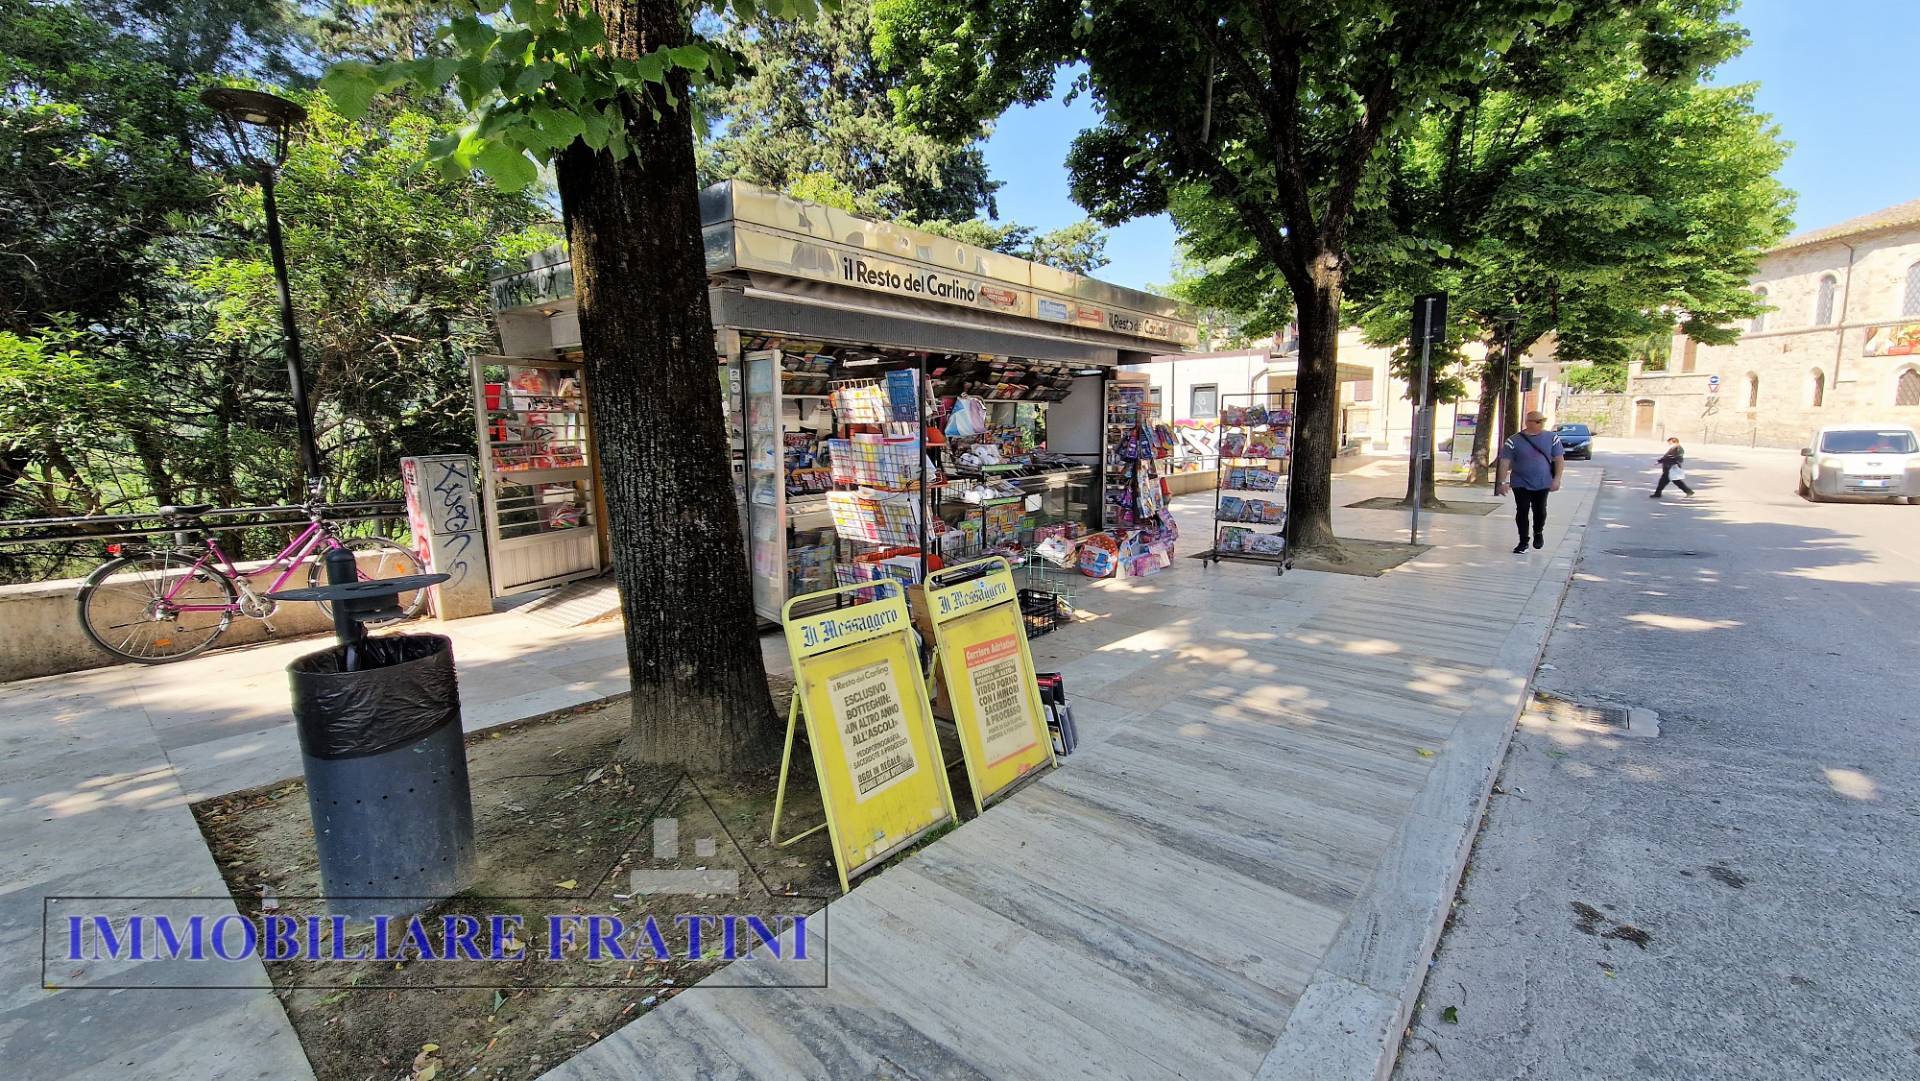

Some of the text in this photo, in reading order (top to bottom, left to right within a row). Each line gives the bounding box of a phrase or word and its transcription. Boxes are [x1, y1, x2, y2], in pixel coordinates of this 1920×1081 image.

[844, 257, 852, 280] il
[856, 260, 900, 289] Resto
[904, 273, 924, 292] del
[927, 274, 975, 302] Carlino
[1114, 314, 1132, 331] Resto
[938, 582, 1006, 614] Il Messaggero
[801, 609, 898, 648] Il Messaggero
[836, 678, 855, 690] Resto
[865, 666, 888, 679] Carlino
[976, 674, 1018, 696] VIDEO PORNO
[844, 682, 886, 706] ESCLUSIVO
[979, 692, 993, 706] CON
[997, 684, 1019, 698] MINORI
[985, 695, 1018, 716] SACERDOTE
[846, 694, 892, 720] BOTTEGHIN:
[859, 712, 879, 729] ALTRO
[881, 703, 899, 720] ANNO
[991, 704, 1021, 724] PROCESSO
